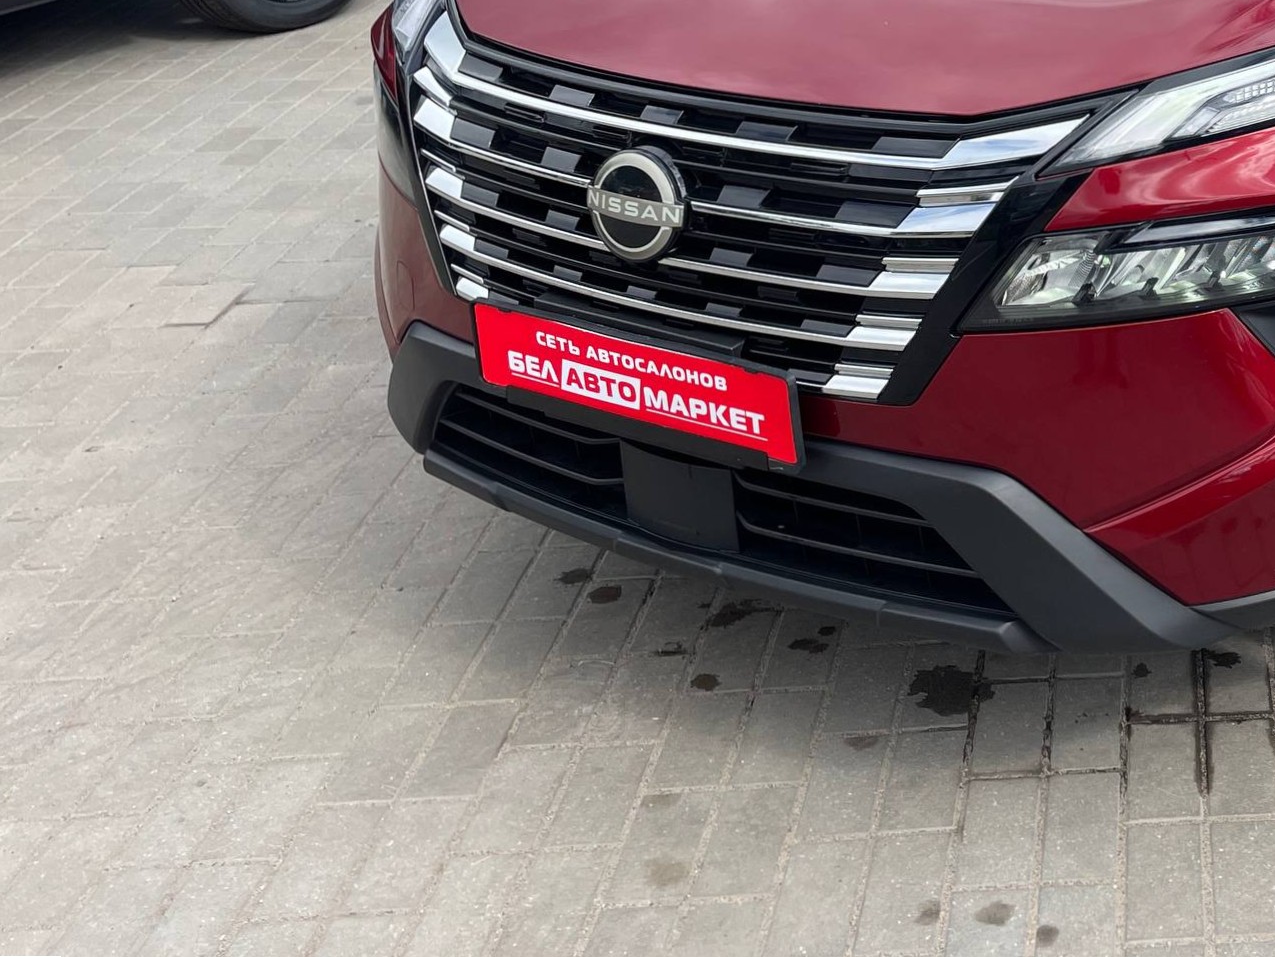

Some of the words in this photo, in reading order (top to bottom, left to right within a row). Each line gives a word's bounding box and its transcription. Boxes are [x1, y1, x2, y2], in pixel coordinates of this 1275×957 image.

[586, 192, 681, 225] NISSAN
[535, 330, 581, 357] СЕТЬ
[585, 344, 728, 392] АВТОСАЛОНОВ
